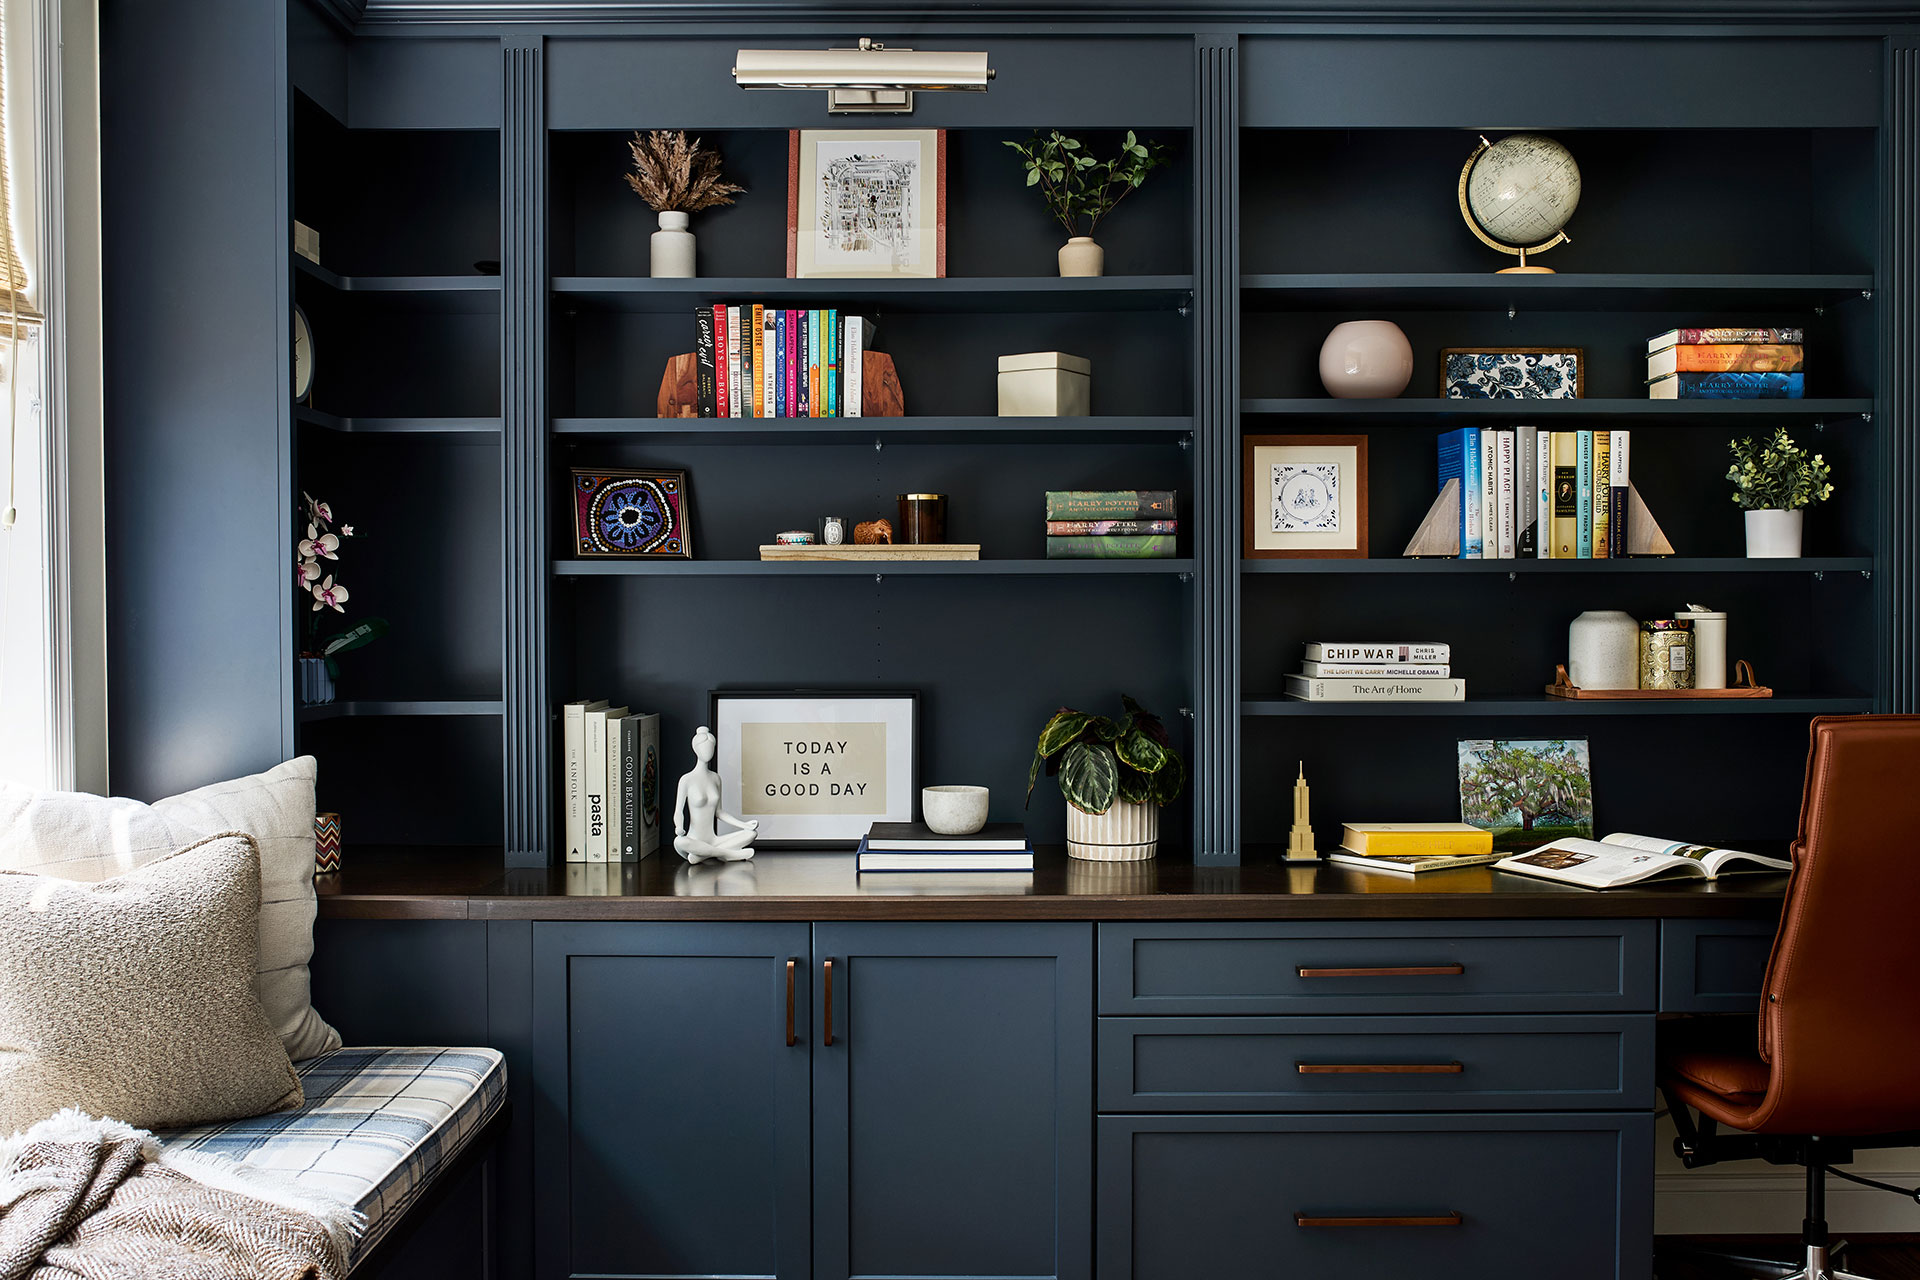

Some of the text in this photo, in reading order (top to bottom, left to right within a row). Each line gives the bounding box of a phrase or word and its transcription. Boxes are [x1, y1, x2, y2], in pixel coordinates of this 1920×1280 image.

[699, 319, 713, 348] career
[742, 319, 750, 336] SARAH
[699, 347, 714, 368] evil
[717, 336, 725, 361] BOYS
[755, 307, 763, 406] EMILY OSTER EXPECTING BETTER
[1469, 433, 1477, 447] Elin
[1503, 437, 1511, 465] HAPPY
[1469, 448, 1478, 486] Hilderbrand
[1540, 460, 1549, 485] Change
[1601, 451, 1610, 480] HARRY
[1503, 467, 1511, 493] PLACE
[1601, 482, 1610, 516] POTTER
[1583, 534, 1588, 543] MD
[1327, 649, 1394, 659] CHIP WAR
[1353, 685, 1423, 696] The Art of Home
[783, 741, 848, 755] TODAY
[570, 761, 578, 800] KINFOLK
[625, 756, 633, 784] COOK
[793, 762, 832, 775] IS A
[765, 782, 867, 797] GOOD DAY
[588, 794, 604, 836] pasta
[625, 786, 633, 838] BEAUTIFUL
[1428, 840, 1456, 850] HELP
